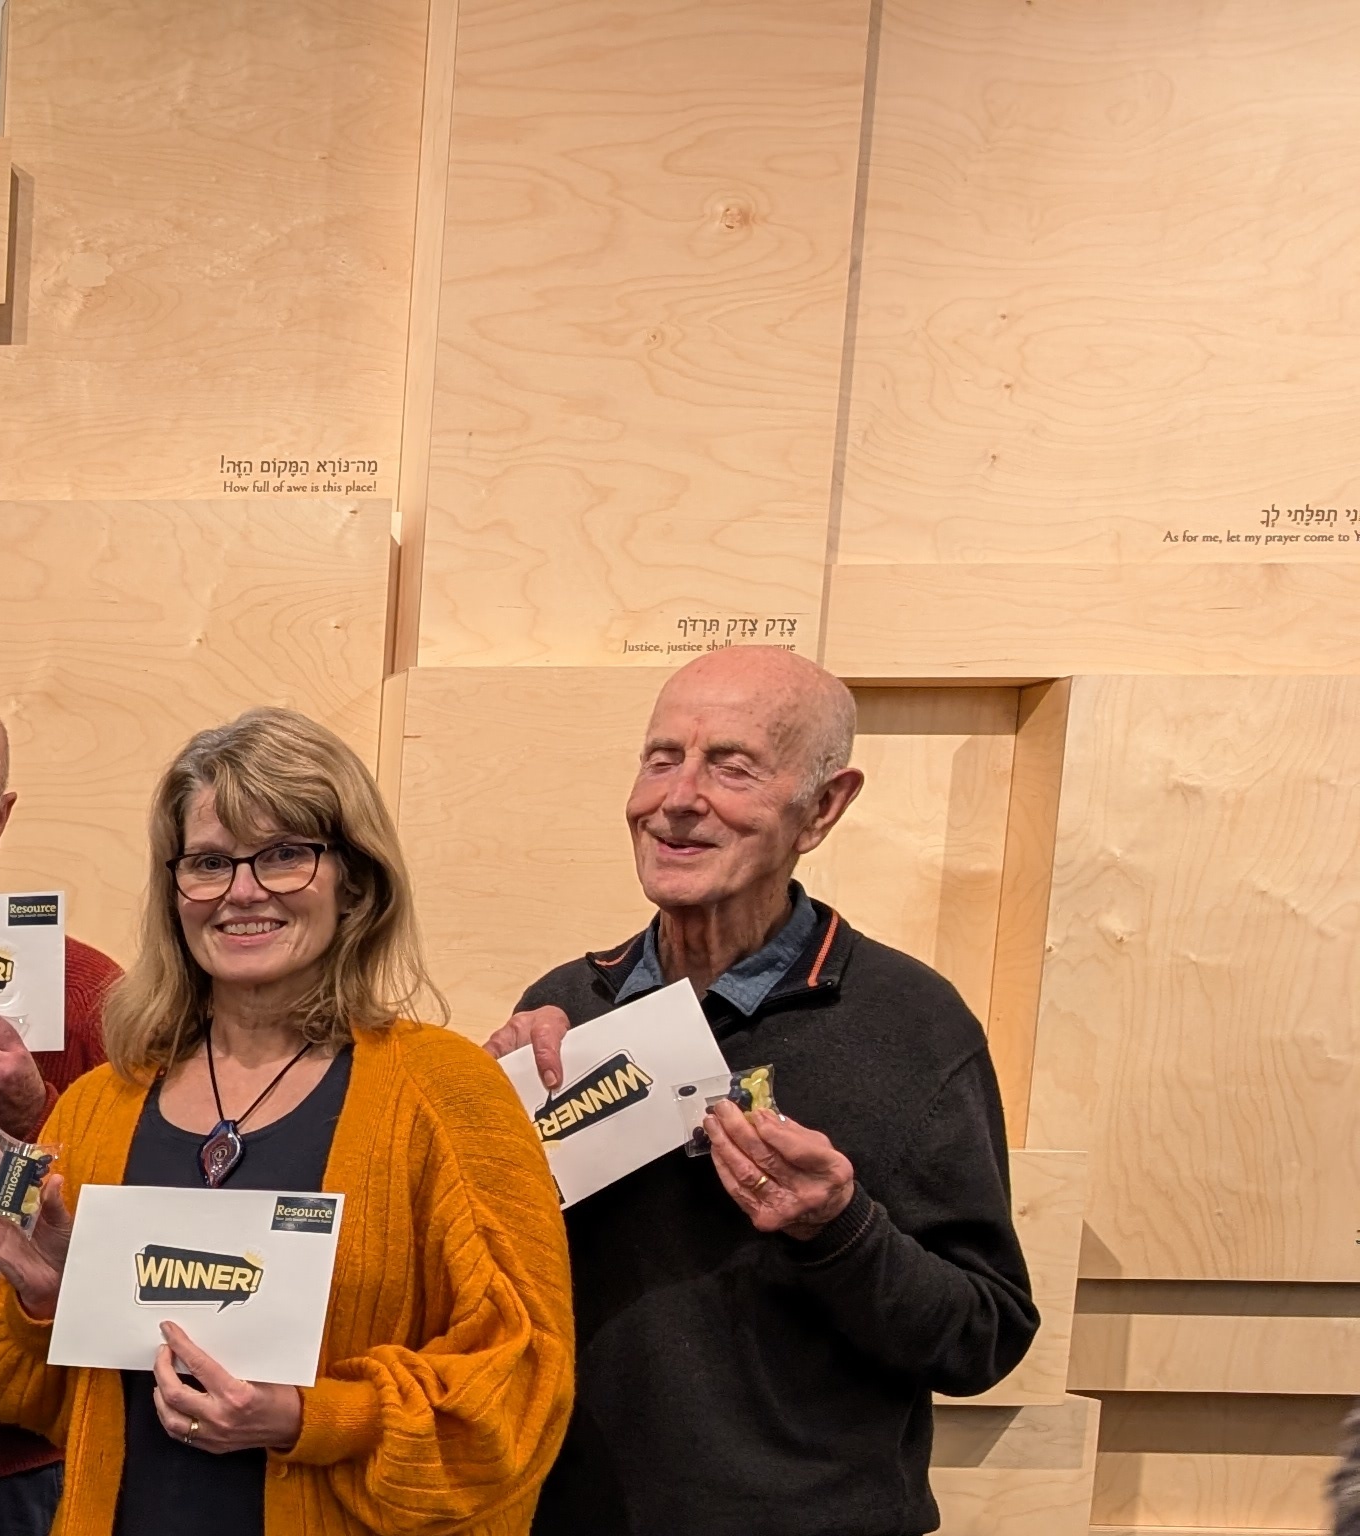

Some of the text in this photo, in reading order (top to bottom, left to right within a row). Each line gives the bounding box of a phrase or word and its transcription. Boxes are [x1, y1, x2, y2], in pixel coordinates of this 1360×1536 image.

[223, 479, 377, 496] How full of awe is this place!
[1162, 530, 1179, 543] As
[1182, 529, 1199, 543] for
[1202, 534, 1223, 544] me,
[1226, 529, 1241, 543] let
[1244, 534, 1262, 546] my
[1264, 534, 1301, 546] prayer
[1303, 534, 1335, 543] come
[1338, 533, 1350, 542] to
[623, 640, 664, 654] Justice,
[666, 641, 703, 655] justice
[9, 903, 57, 914] Resource
[533, 1062, 653, 1141] WINNER!
[1, 1157, 29, 1208] Resource
[275, 1204, 333, 1219] Resource
[136, 1254, 262, 1293] WINNER!
